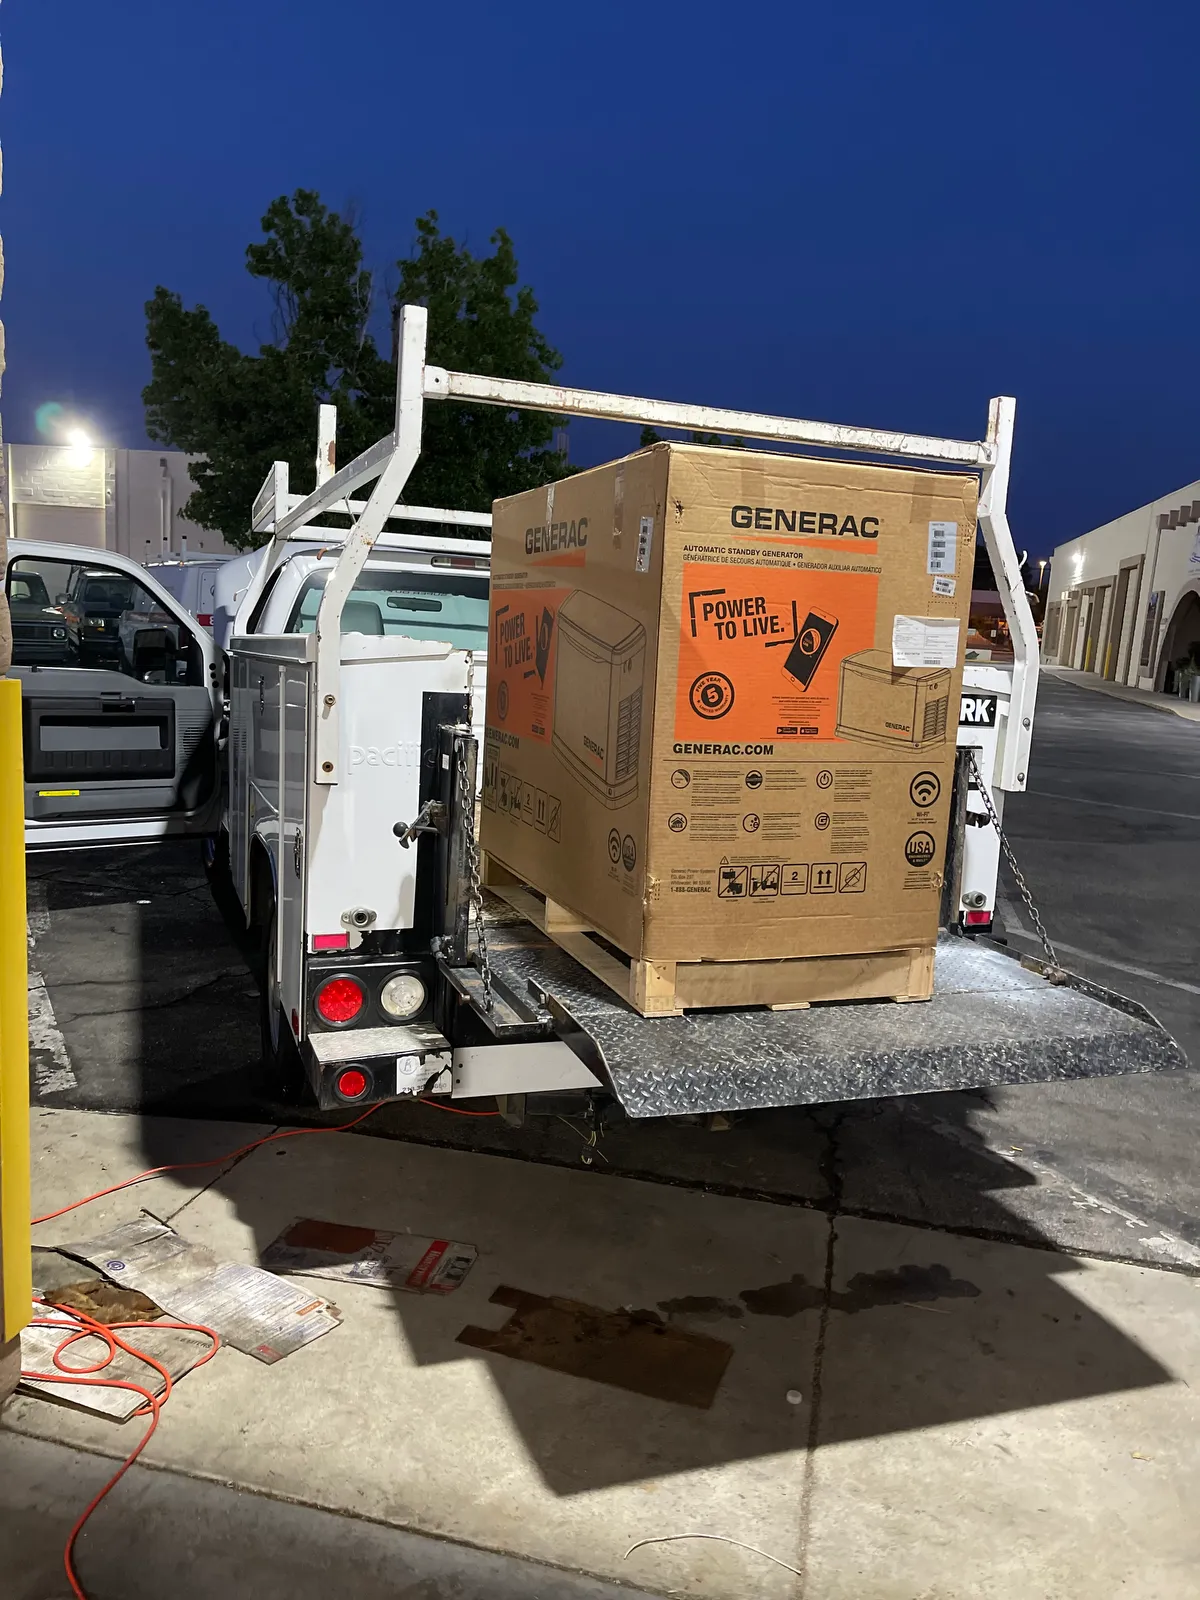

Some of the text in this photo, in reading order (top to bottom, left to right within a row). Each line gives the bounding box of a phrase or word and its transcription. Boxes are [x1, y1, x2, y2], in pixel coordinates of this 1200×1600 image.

[731, 505, 880, 539] GENERAC
[525, 517, 588, 555] GENERAC
[683, 545, 804, 559] AUTOMATIC STANDBY GENERATOR
[683, 553, 720, 563] GÉNÉRATRICE
[730, 556, 754, 565] SECOURS
[755, 559, 791, 568] AUTOMATIQUE
[797, 561, 827, 570] GENERADOR
[828, 563, 851, 571] AUXILIAR
[703, 597, 767, 621] POWER
[500, 612, 525, 646] POWER
[714, 615, 785, 641] TO LIVE.
[504, 636, 533, 669] TO LIVE.
[695, 680, 706, 693] FIVE
[706, 687, 719, 703] 5
[885, 721, 910, 733] GENERAC
[583, 735, 604, 761] GENERAC
[672, 743, 774, 756] GENERAC.COM
[910, 841, 930, 854] USA
[791, 871, 799, 881] 2
